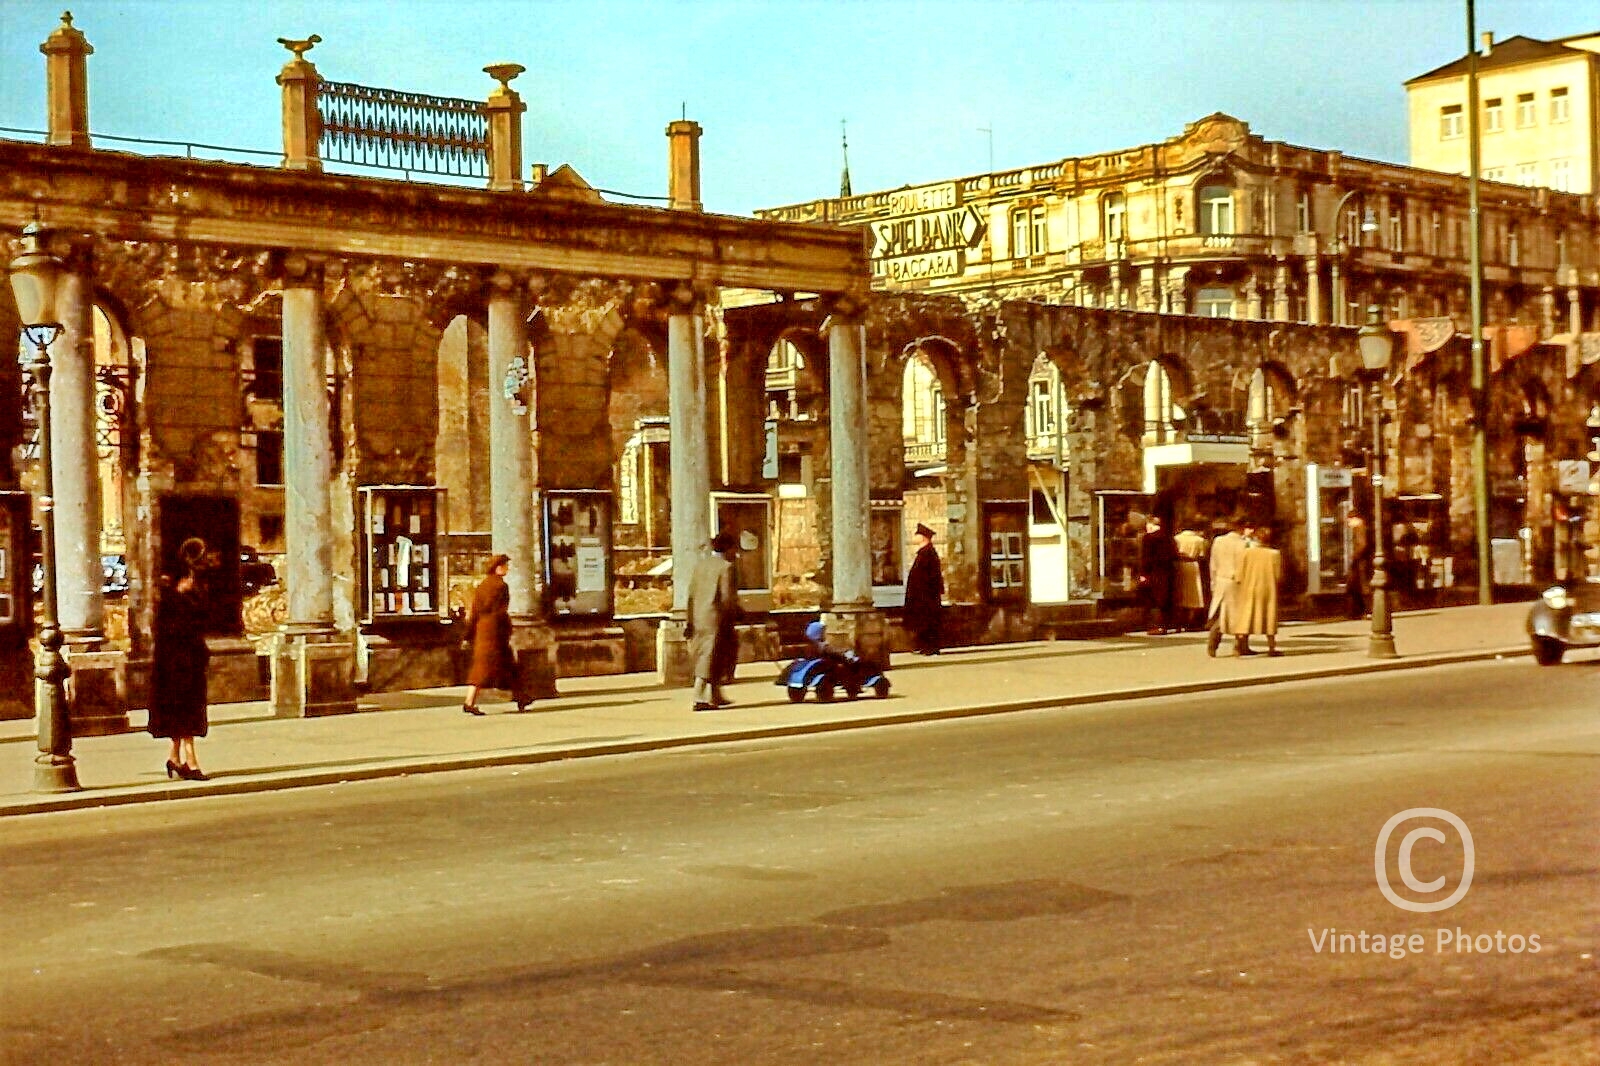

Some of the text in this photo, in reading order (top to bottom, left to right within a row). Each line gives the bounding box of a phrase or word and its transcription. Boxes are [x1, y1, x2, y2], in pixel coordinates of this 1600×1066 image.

[890, 187, 953, 214] ROULETTE
[879, 210, 968, 257] SPIELBANK
[893, 255, 954, 280] BACCARA
